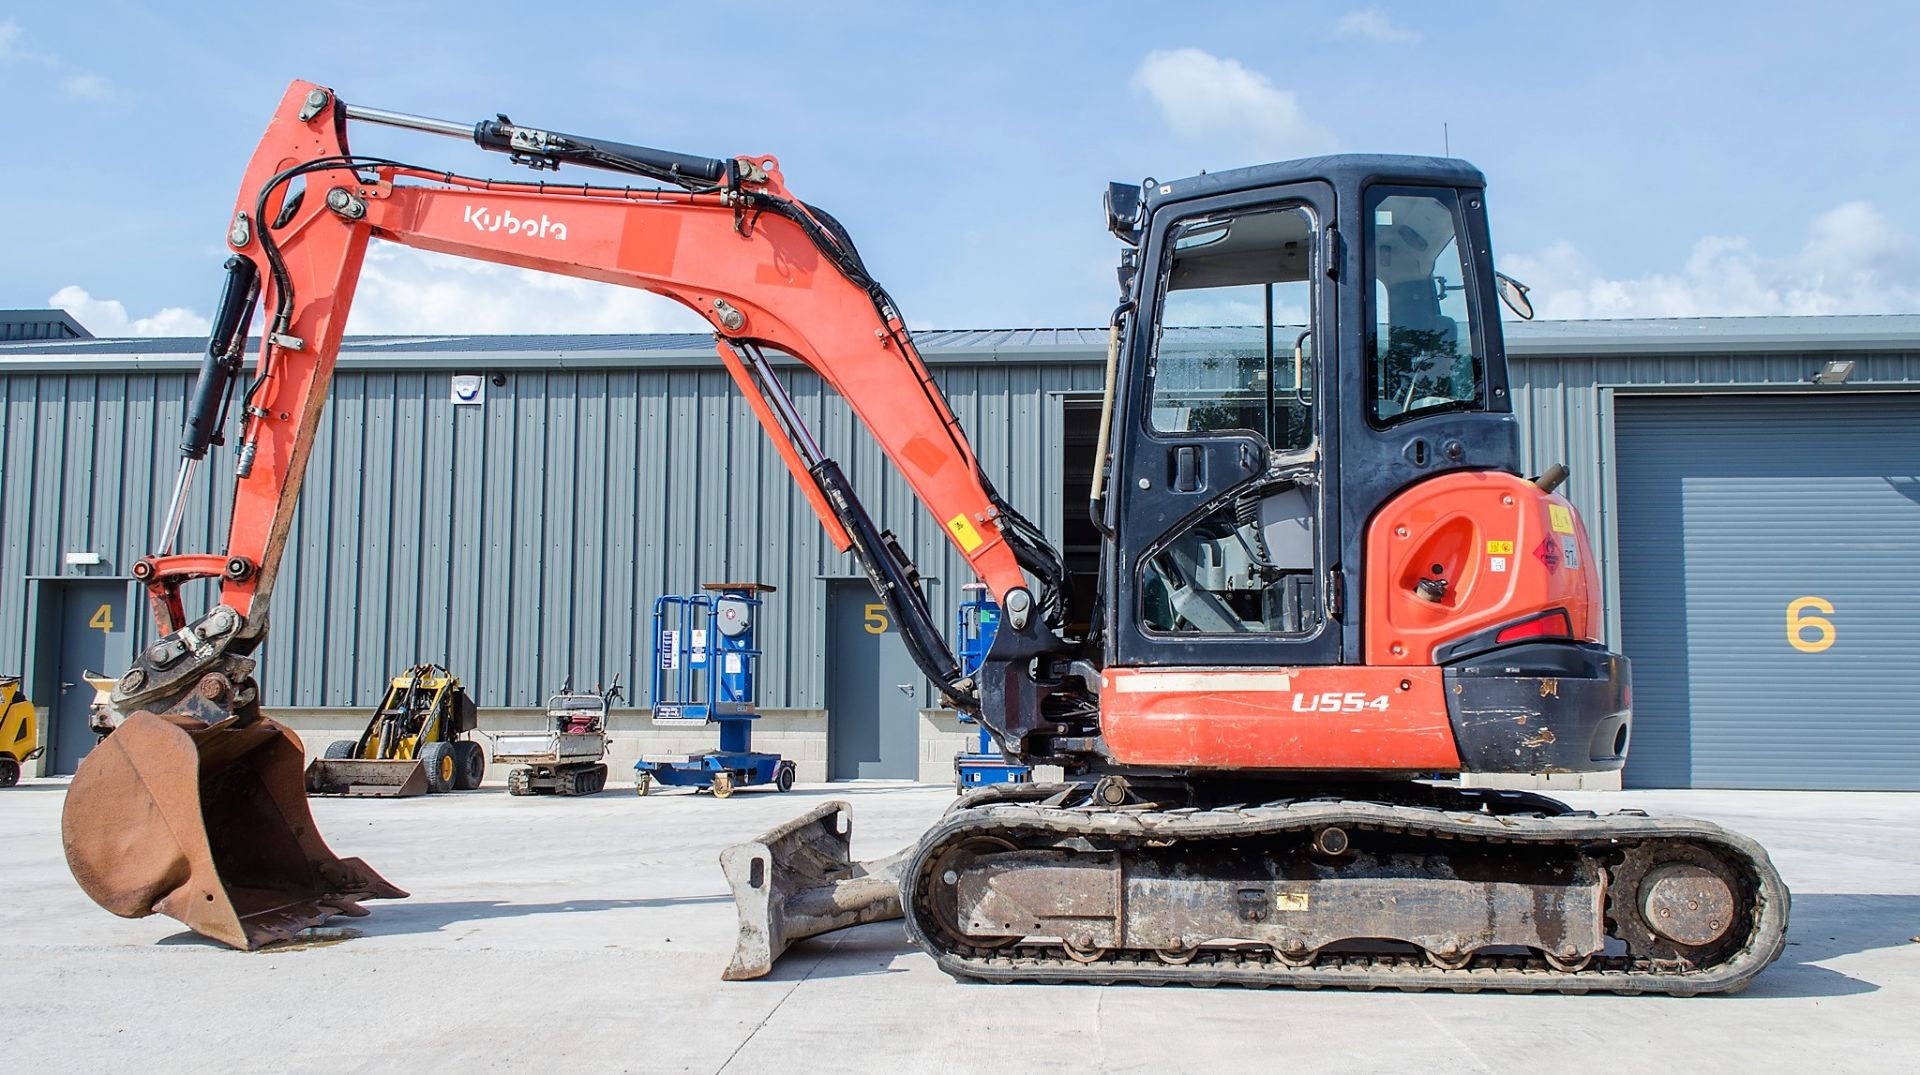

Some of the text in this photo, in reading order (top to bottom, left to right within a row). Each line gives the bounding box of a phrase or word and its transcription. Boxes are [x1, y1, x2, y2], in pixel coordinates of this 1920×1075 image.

[463, 205, 568, 241] Kubota
[89, 604, 113, 634] 4
[864, 603, 888, 634] 5
[1786, 596, 1836, 653] 6
[1291, 692, 1390, 713] U55-4
